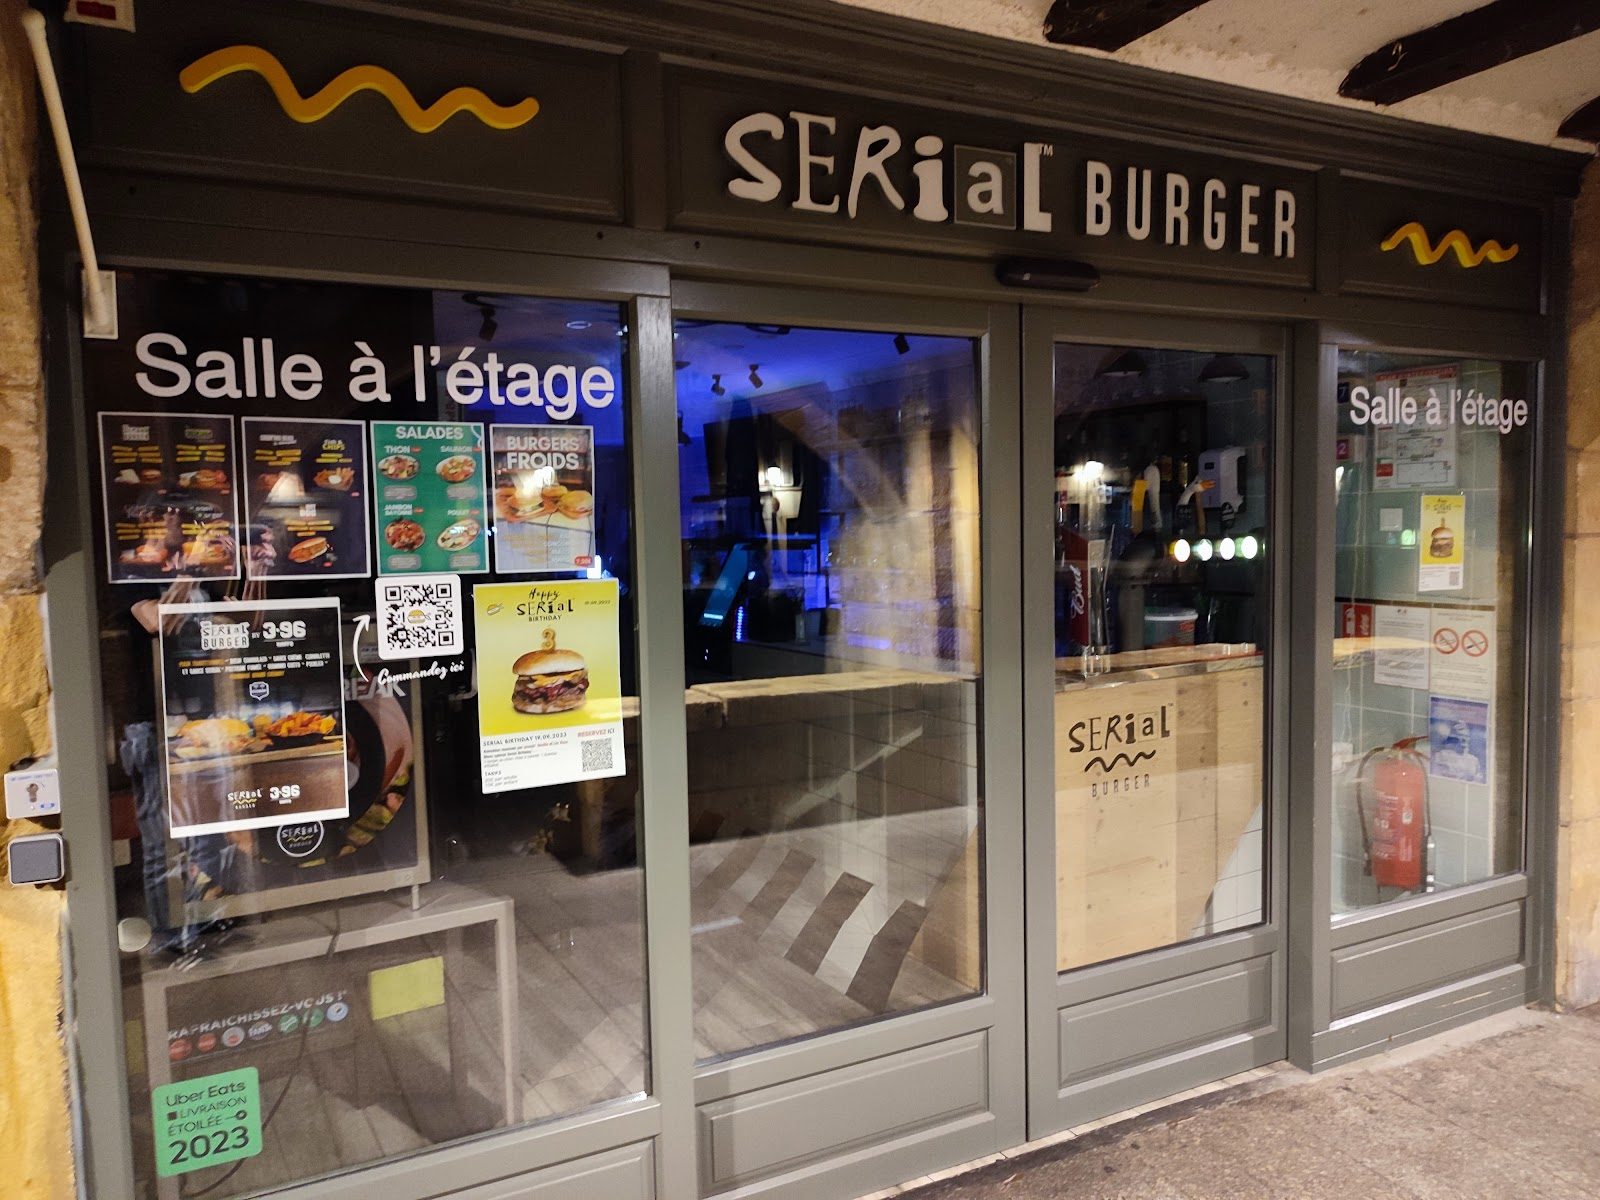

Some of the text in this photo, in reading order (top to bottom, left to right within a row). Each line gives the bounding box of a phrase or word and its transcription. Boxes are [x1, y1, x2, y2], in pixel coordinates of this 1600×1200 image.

[1086, 160, 1297, 259] BURGER
[135, 332, 615, 421] Salle à l'étage
[1350, 386, 1529, 434] Salle à l'étage
[395, 426, 464, 440] SALADES
[507, 436, 580, 451] BURGERS
[384, 445, 411, 454] THON
[507, 452, 580, 470] FROIDS
[529, 588, 559, 601] Happy
[203, 637, 248, 649] BURGER
[377, 660, 465, 685] Commandez ici
[505, 736, 534, 744] BIRTHDAY
[1092, 773, 1150, 798] BURGER
[166, 1082, 246, 1107] Uber Eats
[180, 1096, 248, 1119] LIVRAISON
[168, 1114, 222, 1137] ÉTOILÉE
[168, 1126, 249, 1165] 2023
